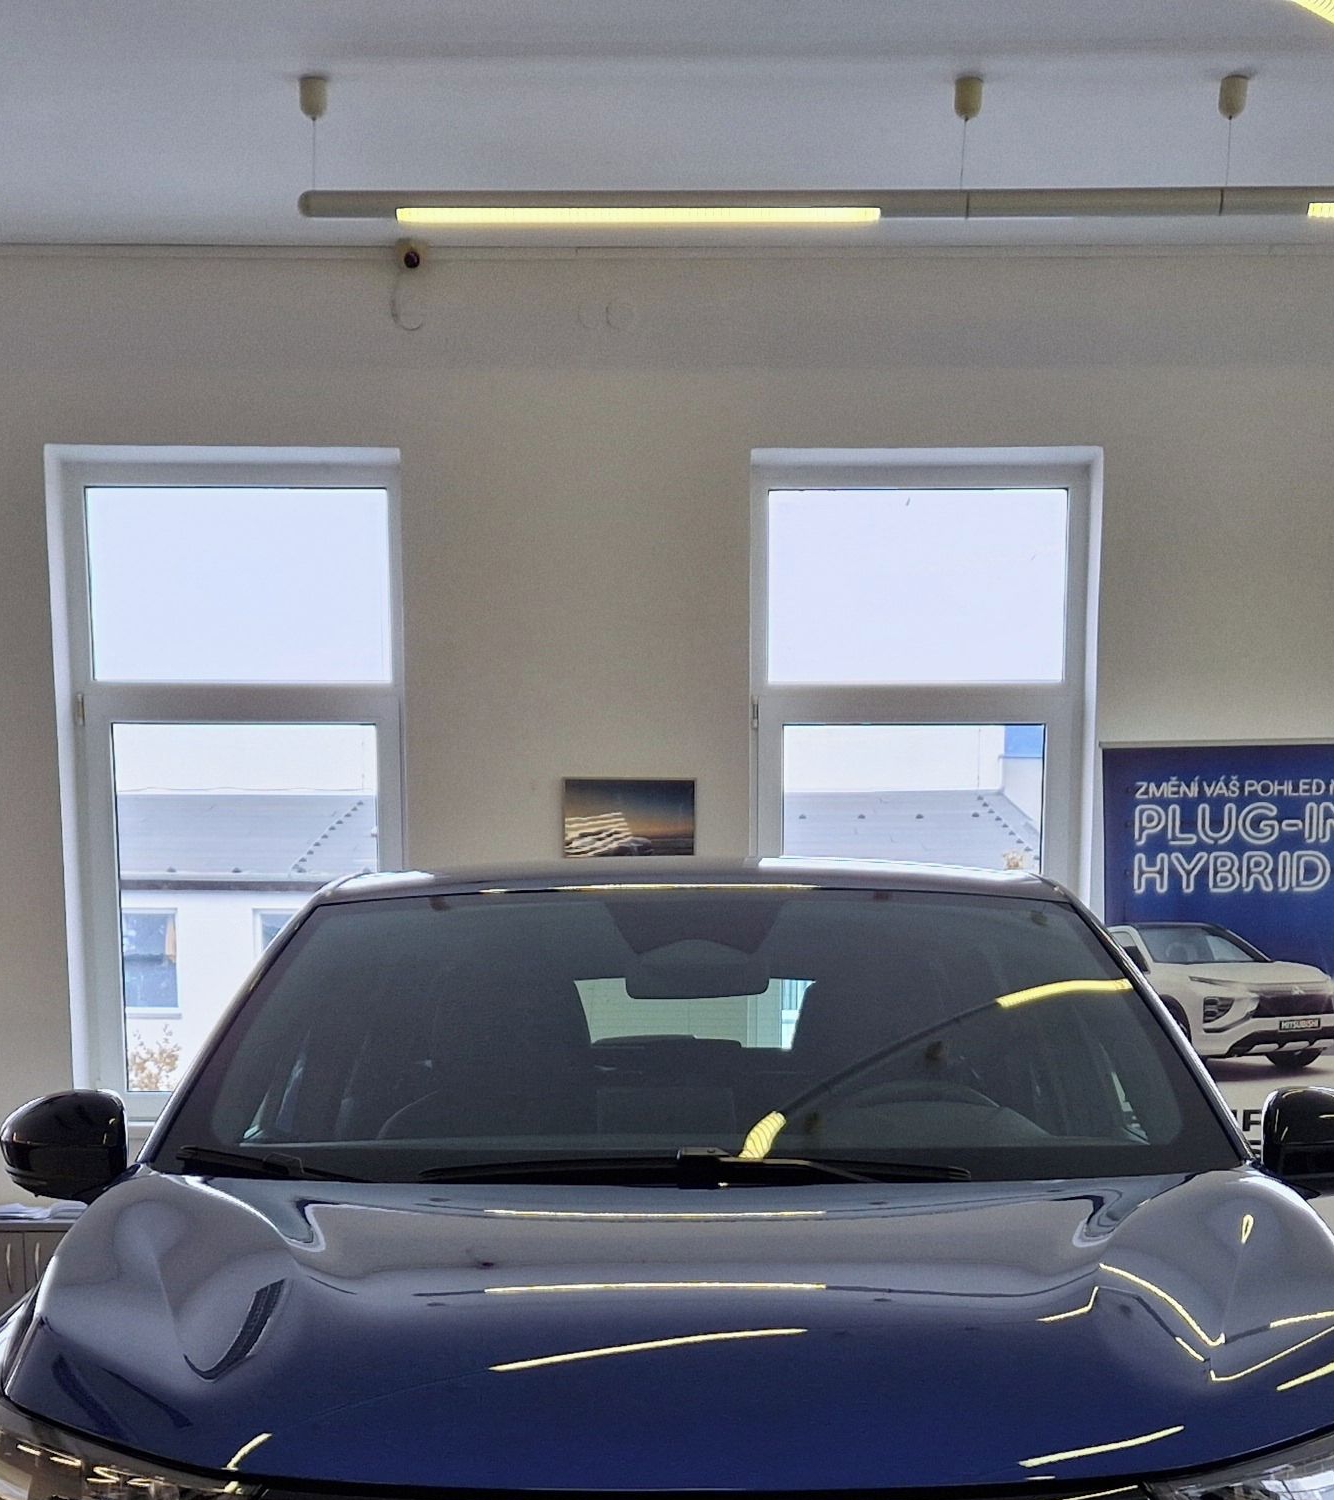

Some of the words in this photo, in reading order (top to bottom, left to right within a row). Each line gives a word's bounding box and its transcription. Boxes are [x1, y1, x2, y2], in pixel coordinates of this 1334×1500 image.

[1135, 775, 1199, 798] ZMĚNÍ
[1202, 774, 1241, 797] VÁŠ
[1244, 778, 1326, 797] POHLED
[1133, 850, 1332, 893] HYBRID
